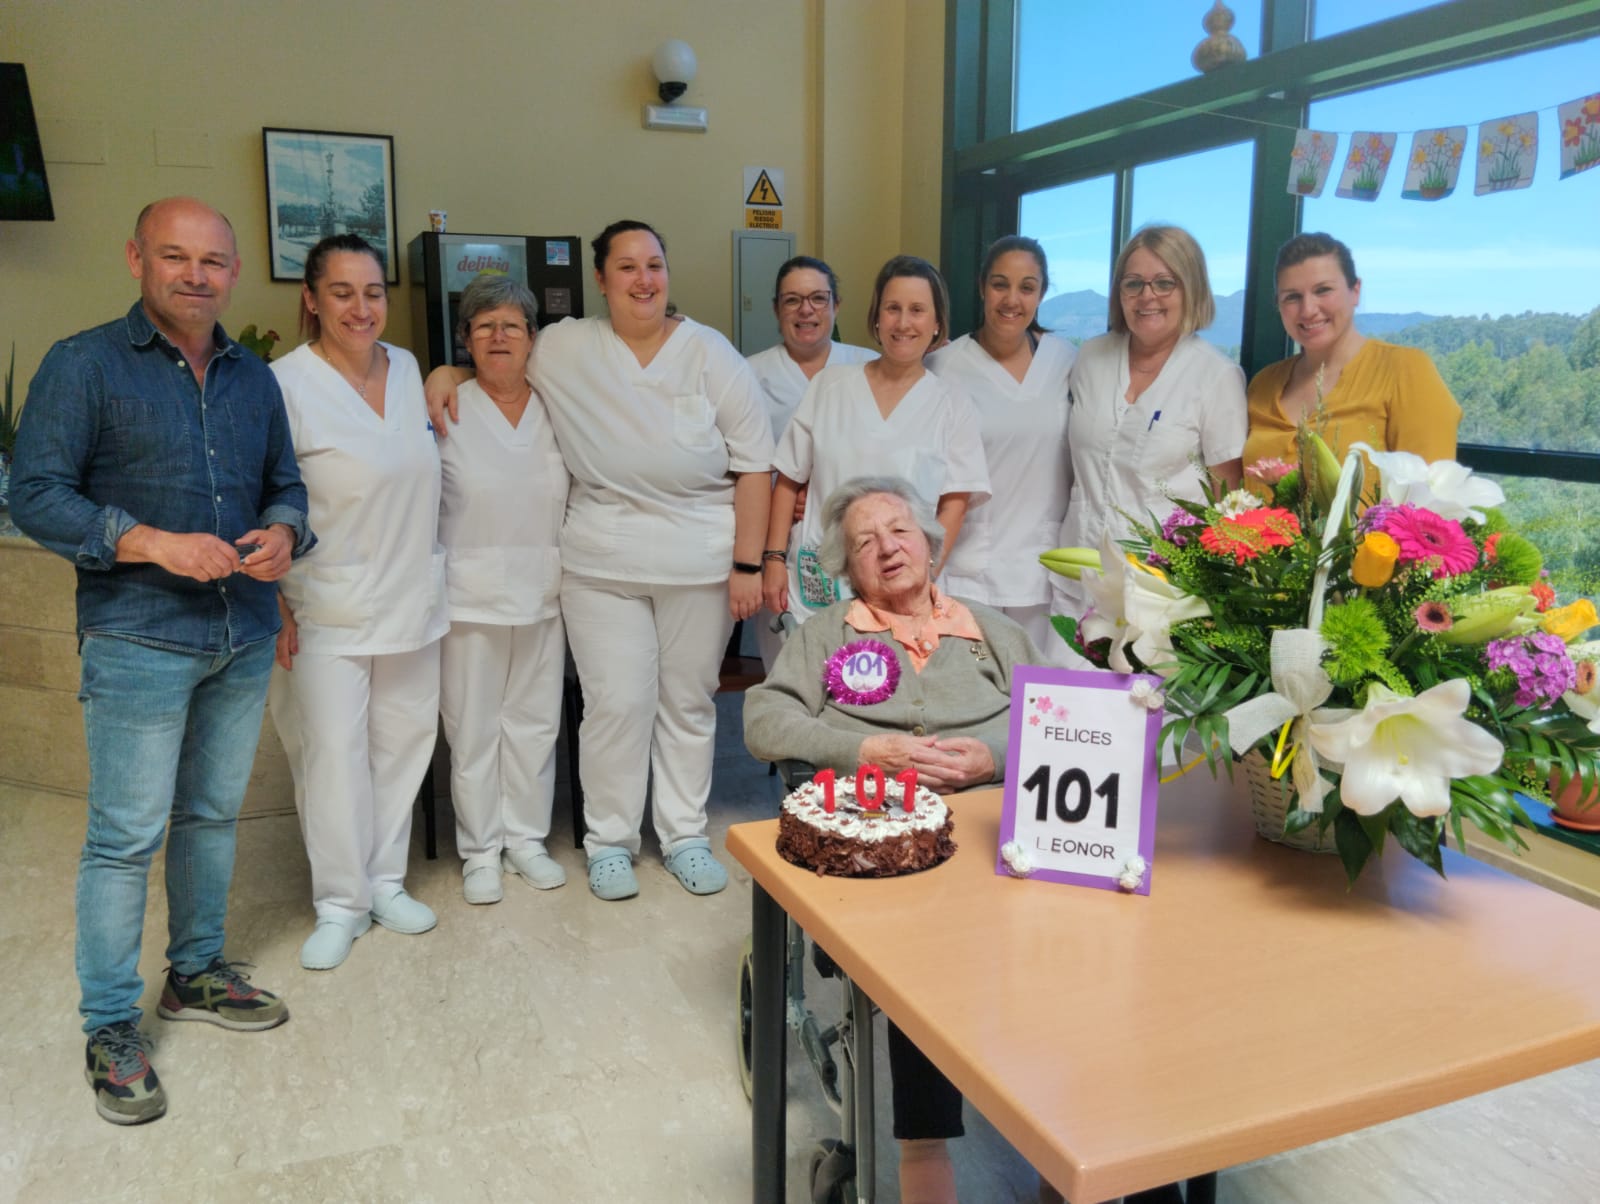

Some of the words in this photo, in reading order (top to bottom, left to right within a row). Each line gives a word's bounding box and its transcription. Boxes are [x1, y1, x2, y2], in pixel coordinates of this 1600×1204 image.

[457, 255, 510, 272] delikia
[845, 653, 883, 677] 101
[1044, 726, 1113, 746] FELICES
[1022, 765, 1120, 829] 101
[1036, 836, 1116, 860] LEONOR
